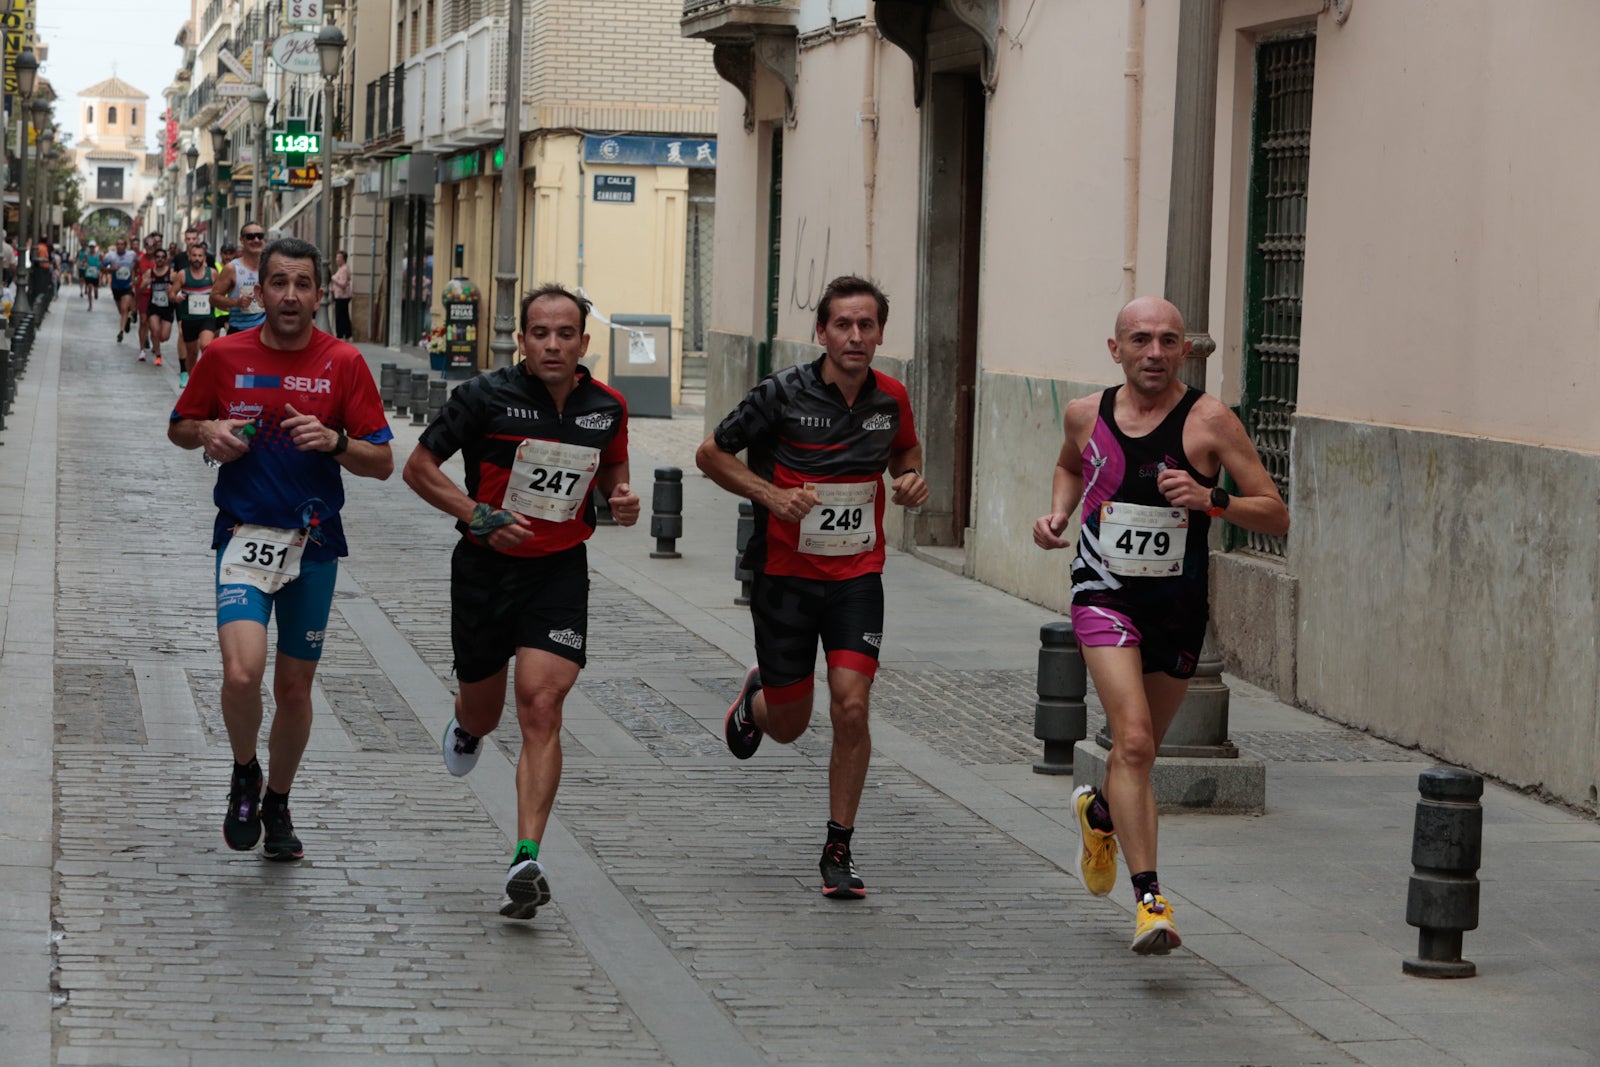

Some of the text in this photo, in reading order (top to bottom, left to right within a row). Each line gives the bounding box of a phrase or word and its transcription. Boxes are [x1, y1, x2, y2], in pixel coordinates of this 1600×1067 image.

[607, 176, 632, 185] CALLE
[283, 376, 331, 393] SEUR
[529, 468, 581, 496] 247
[820, 508, 862, 531] 249
[1115, 529, 1170, 556] 479
[242, 542, 288, 569] 351
